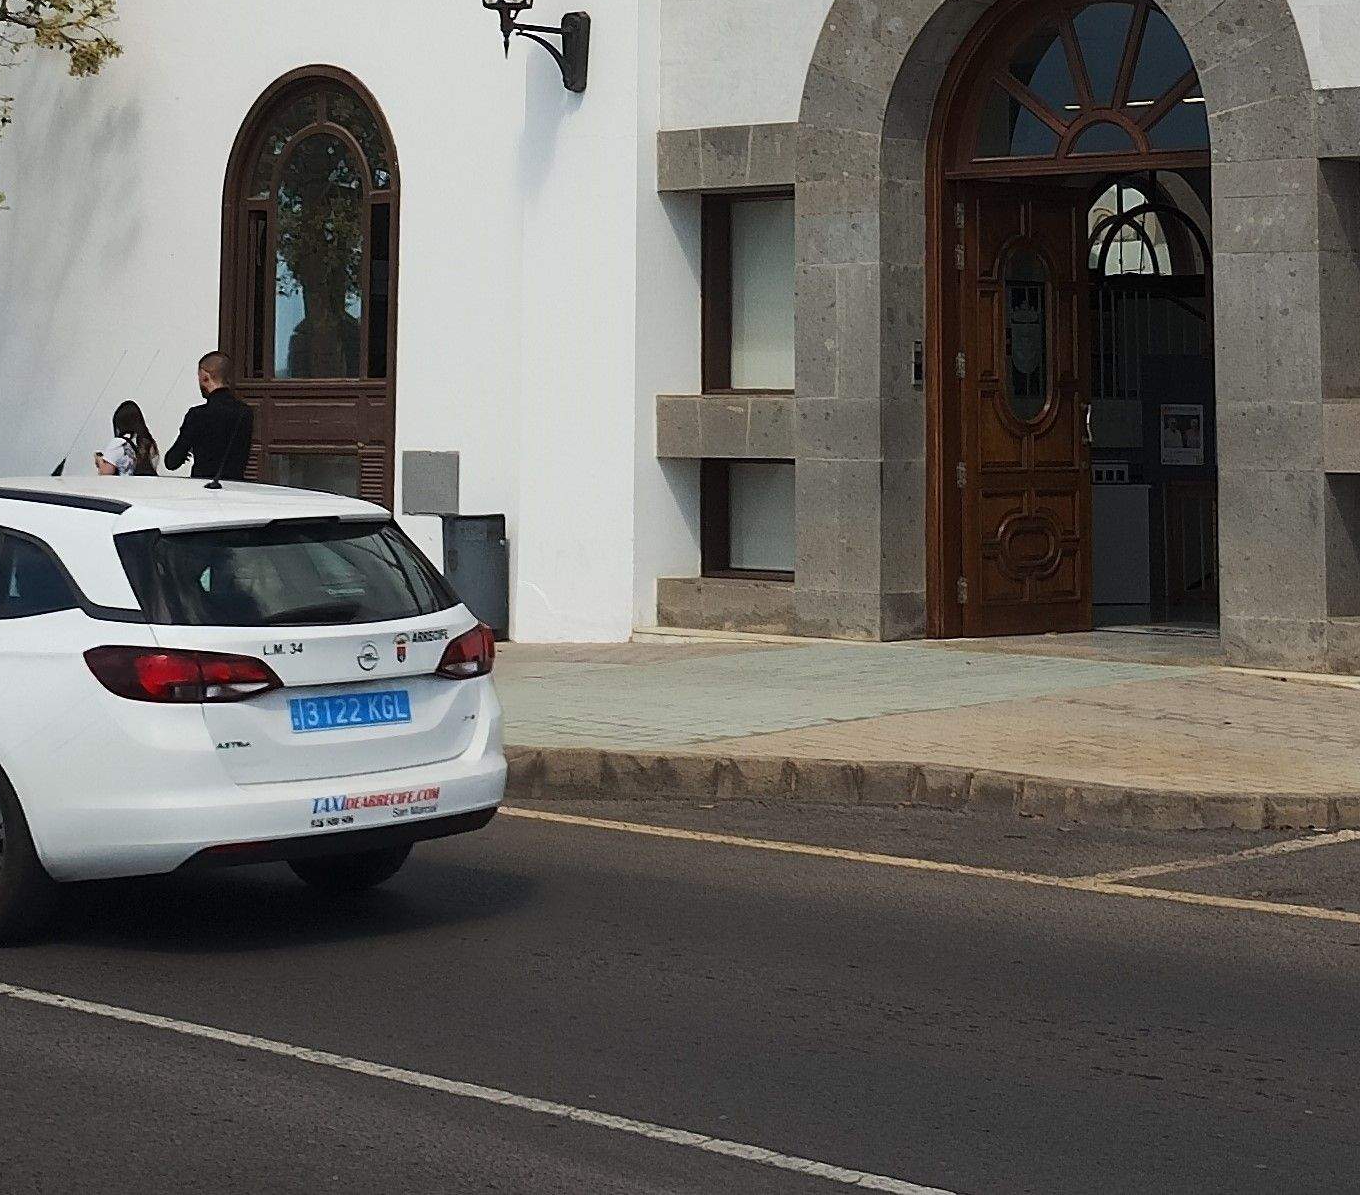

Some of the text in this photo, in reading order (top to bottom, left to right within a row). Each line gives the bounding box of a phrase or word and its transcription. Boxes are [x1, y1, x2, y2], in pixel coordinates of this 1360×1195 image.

[412, 628, 449, 642] ARRECIFE
[289, 642, 304, 654] 34
[307, 693, 409, 726] 3122 KGL
